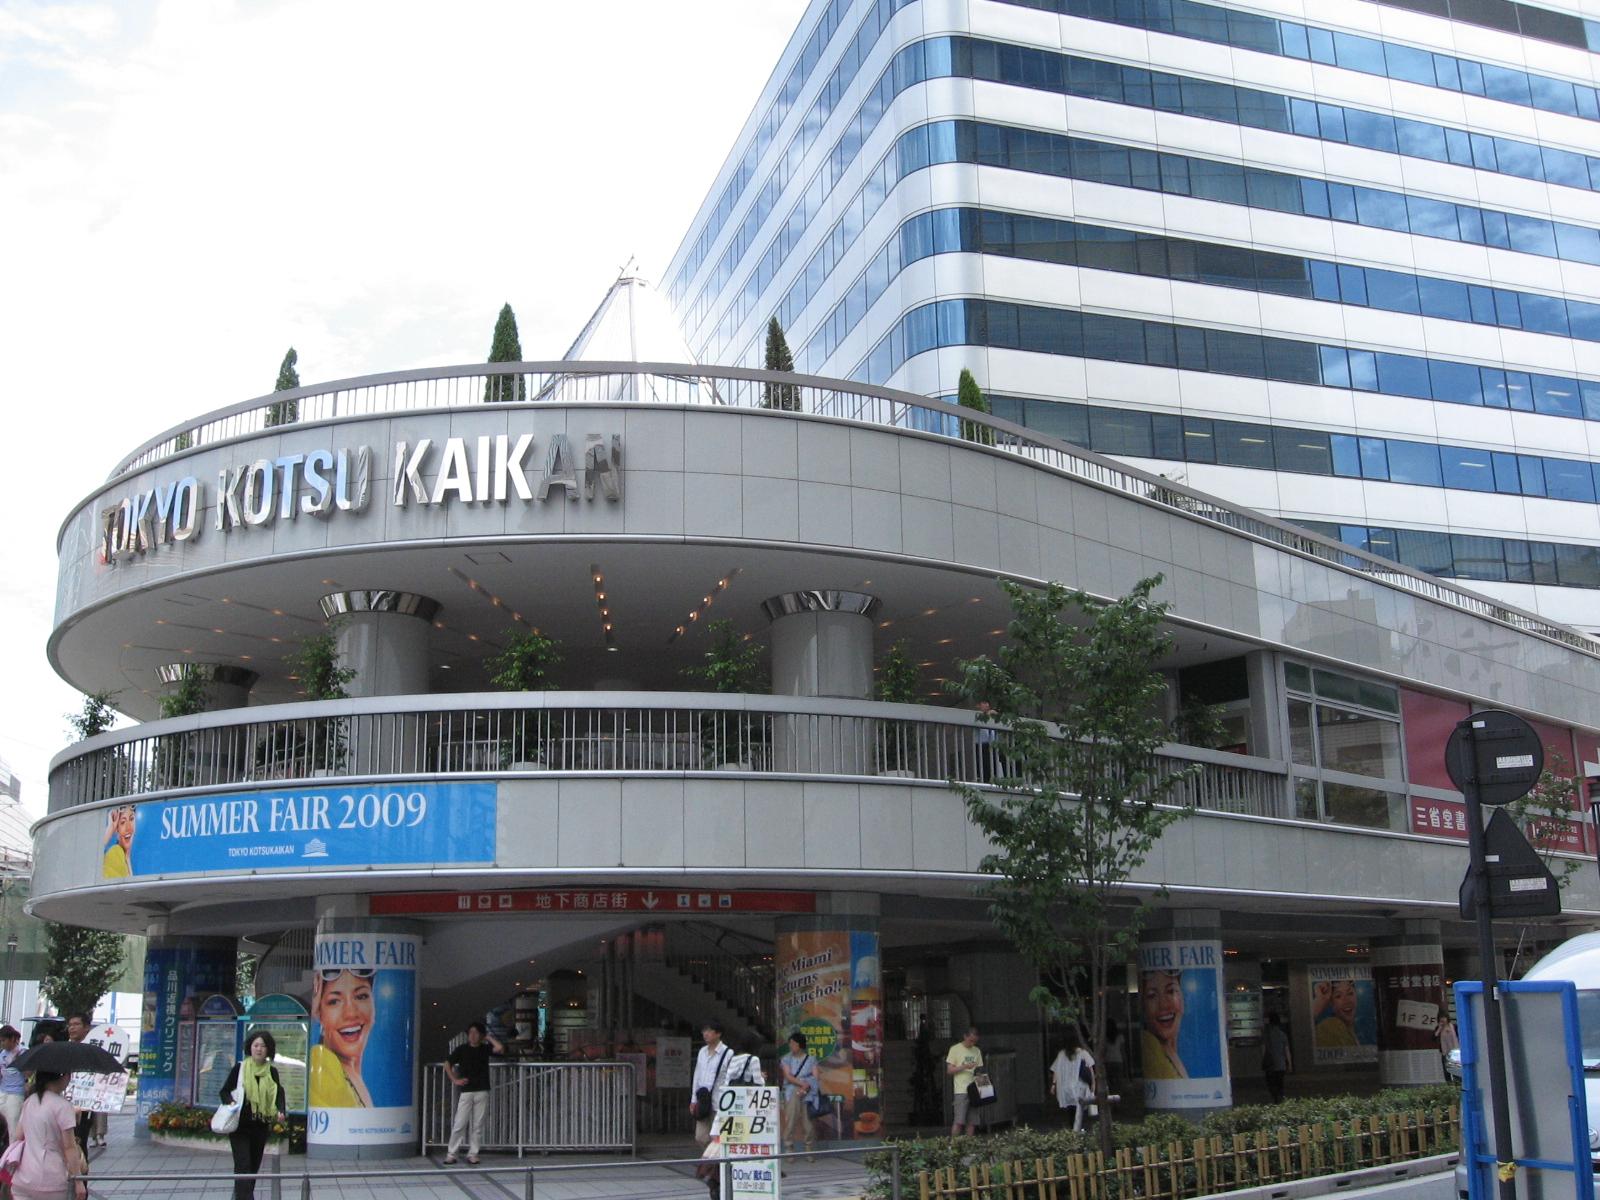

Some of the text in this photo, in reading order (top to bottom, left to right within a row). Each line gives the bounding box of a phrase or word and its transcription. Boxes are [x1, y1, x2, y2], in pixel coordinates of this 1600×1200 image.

[101, 433, 621, 565] TOKYO KOTSU KAIKAN
[160, 792, 427, 840] SUMMER FAIR 2009
[228, 844, 295, 857] TOKYO KOTSUKAIKAN
[535, 892, 628, 909] 地下商店街
[376, 941, 416, 965] FAIR
[791, 949, 832, 972] Miami
[1180, 945, 1216, 966] FAIR
[1422, 1014, 1436, 1025] 2F
[719, 1089, 736, 1112] O
[749, 1089, 771, 1110] AB
[308, 1110, 330, 1135] 09
[719, 1116, 735, 1136] A
[749, 1116, 767, 1135] B
[729, 1144, 771, 1156] 成分献血
